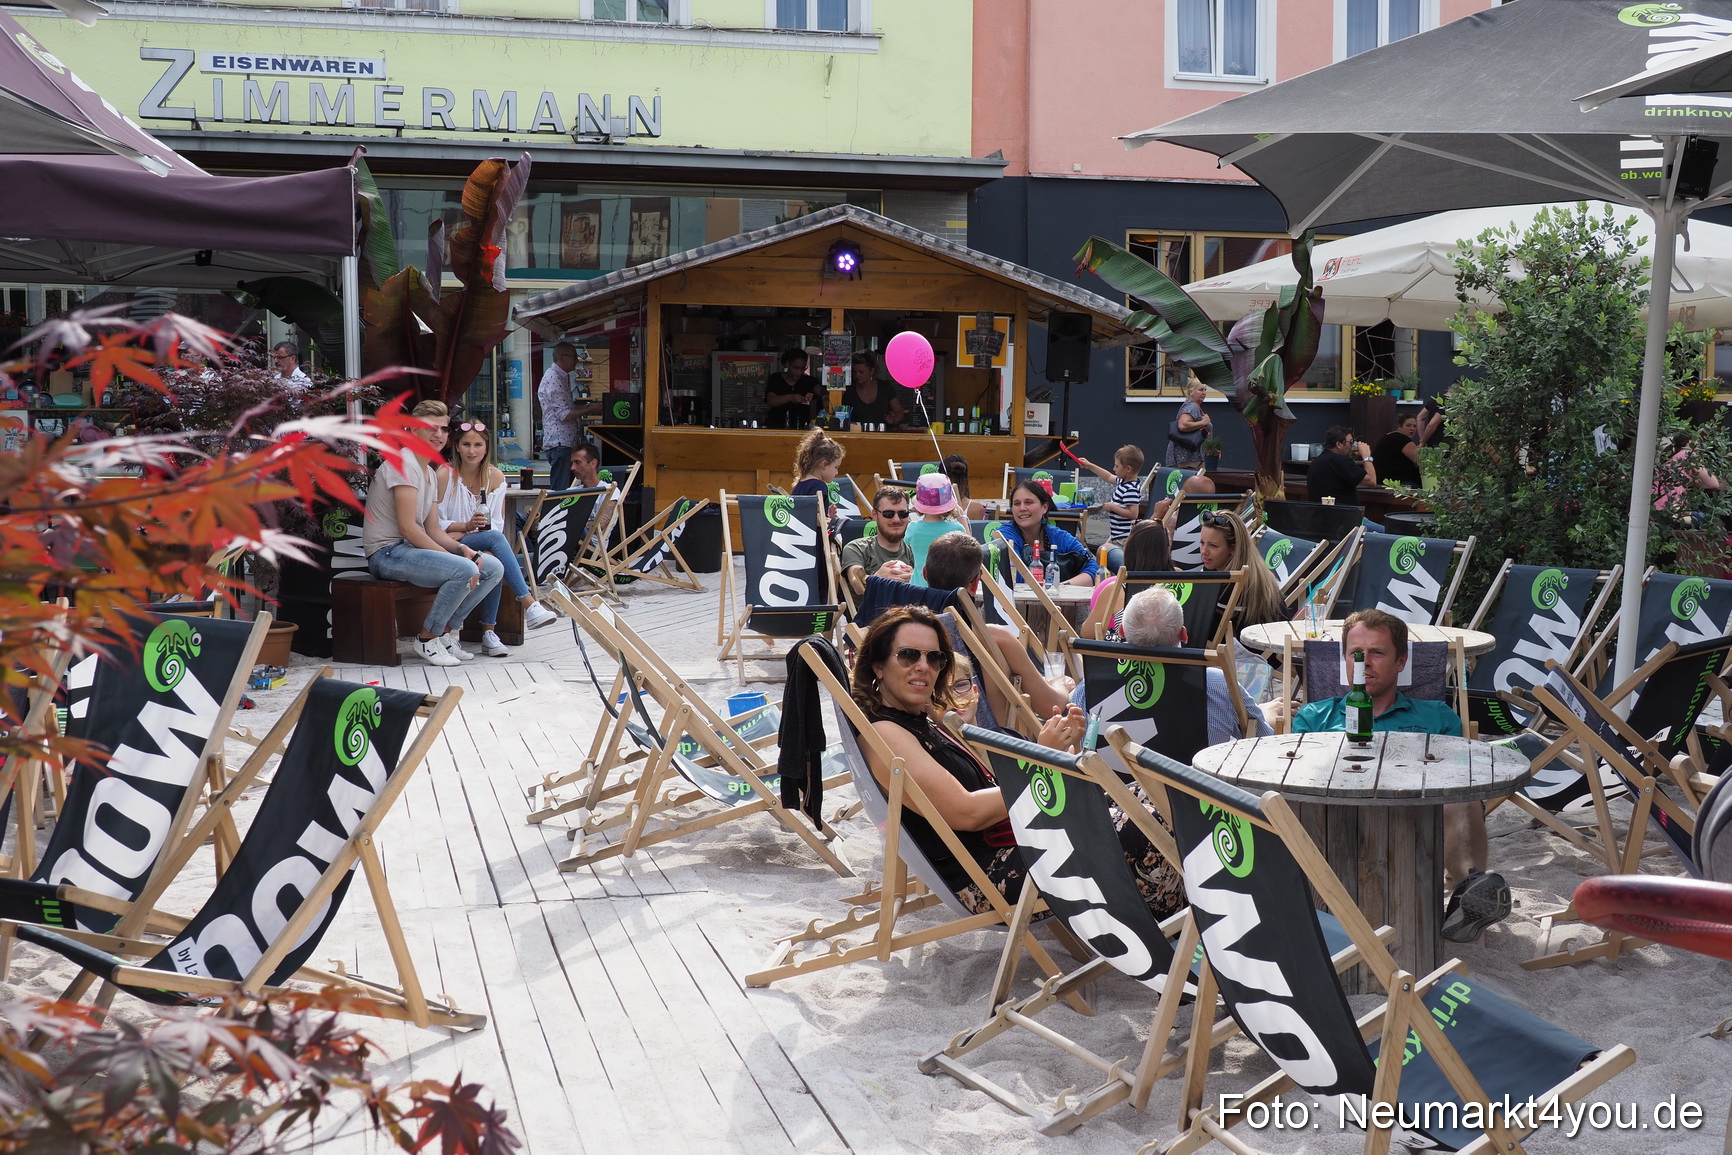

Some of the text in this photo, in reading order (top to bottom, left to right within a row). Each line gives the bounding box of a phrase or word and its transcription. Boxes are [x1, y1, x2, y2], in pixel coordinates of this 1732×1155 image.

[212, 55, 374, 75] EISENWAREN
[139, 47, 661, 138] ZIMMERMANN
[737, 365, 760, 374] BEACH
[178, 947, 192, 963] by
